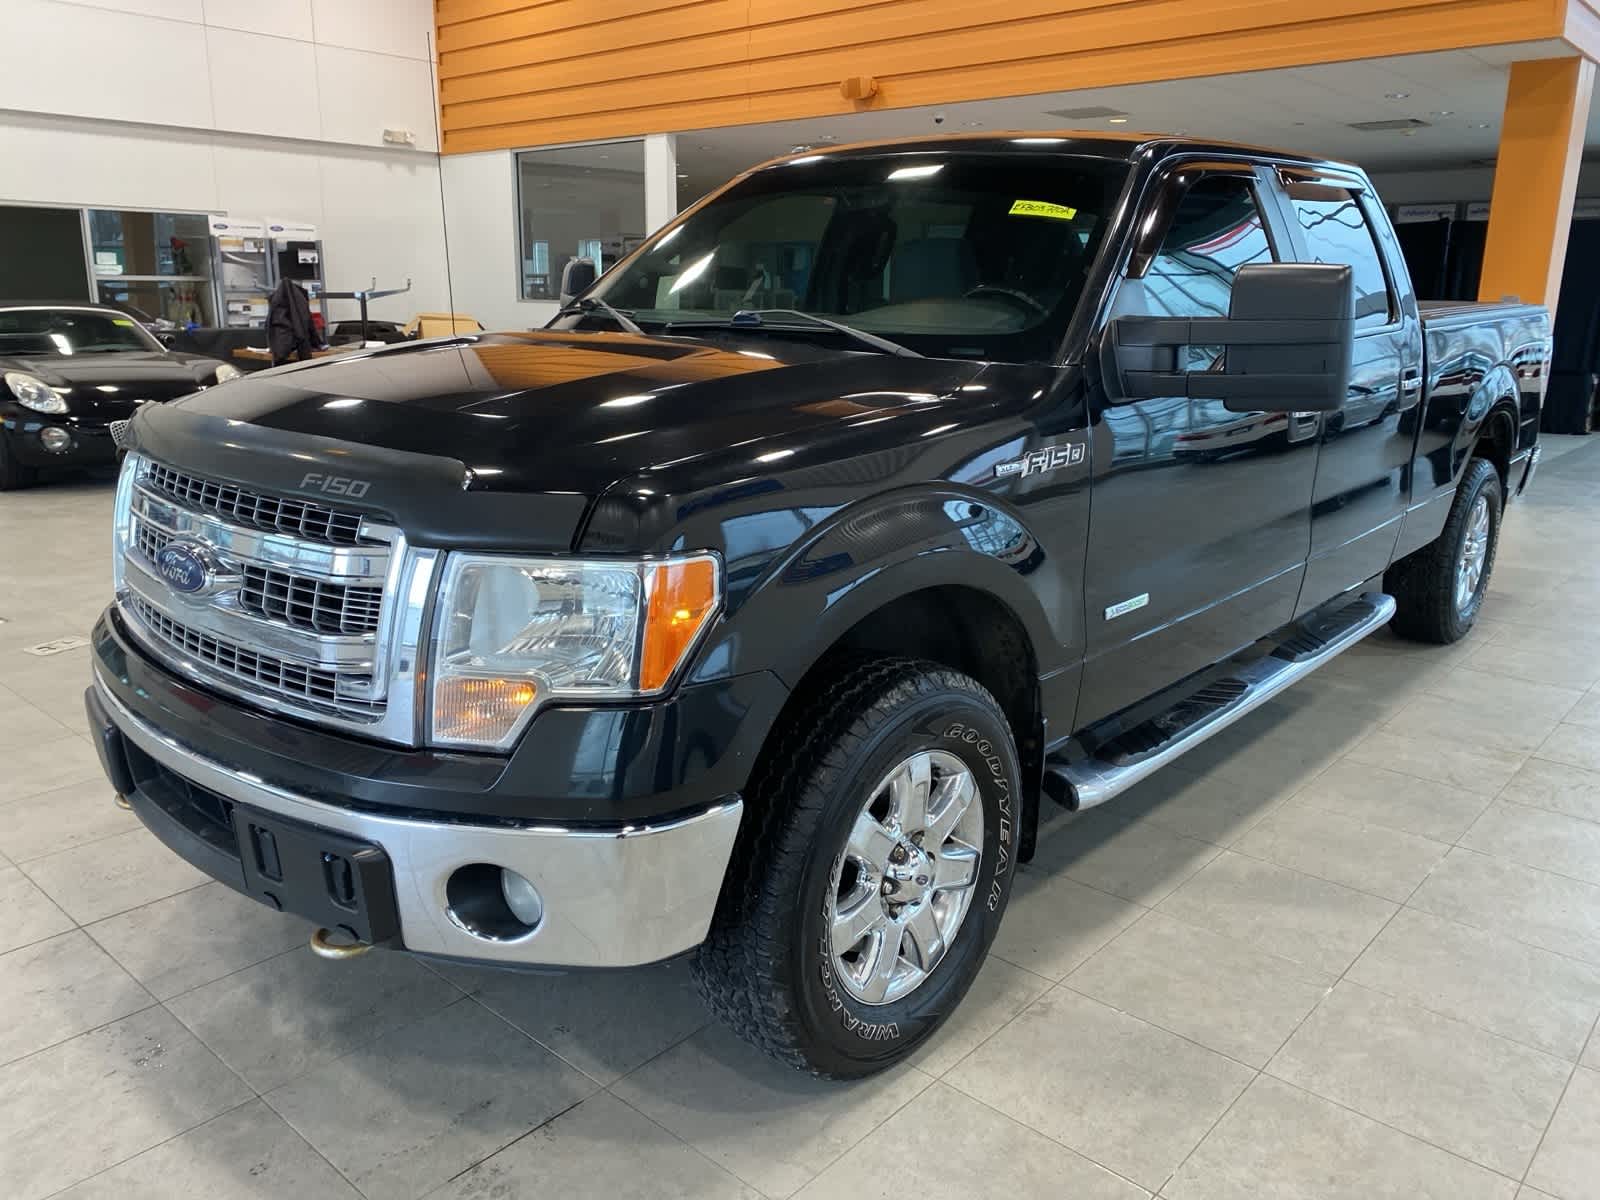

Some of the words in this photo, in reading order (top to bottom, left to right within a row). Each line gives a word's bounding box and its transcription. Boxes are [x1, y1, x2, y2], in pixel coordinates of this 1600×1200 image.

[300, 473, 371, 498] F-150
[161, 551, 194, 585] Ford
[943, 723, 1011, 911] GOODYEAR
